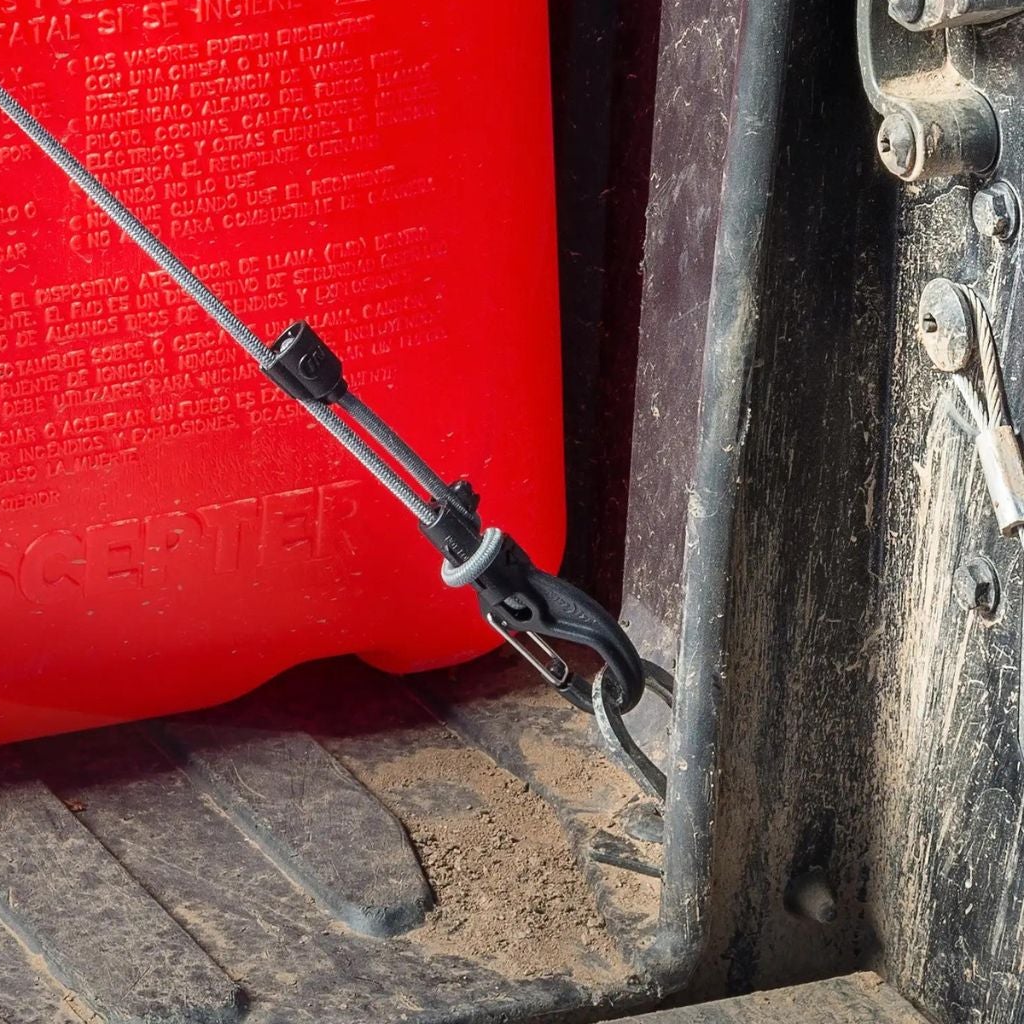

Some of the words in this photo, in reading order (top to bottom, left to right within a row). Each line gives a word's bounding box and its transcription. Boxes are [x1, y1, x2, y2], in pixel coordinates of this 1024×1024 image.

[96, 7, 125, 35] SI
[141, 0, 179, 29] SE
[83, 52, 116, 72] LOS
[124, 42, 200, 64] VAPORES
[206, 33, 270, 54] PUEDEN
[84, 72, 122, 91] CON
[128, 66, 163, 85] UNA
[167, 59, 230, 78] CHISPA
[236, 54, 251, 71] O
[258, 49, 292, 67] UNA
[298, 41, 350, 62] LLAMA
[84, 90, 139, 112] DESDE
[145, 85, 179, 103] UNA
[188, 73, 272, 96] DISTANCIA
[280, 68, 300, 85] DE
[308, 58, 364, 80] VARIOS
[200, 93, 272, 114] ALEJADO
[278, 87, 304, 105] DEL
[84, 130, 146, 150] PILOTO,
[154, 119, 231, 140] COCINAS,
[192, 140, 206, 156] Y
[210, 132, 266, 154] OTRAS
[270, 123, 342, 143] FUENTES
[179, 159, 203, 177] EL
[207, 148, 300, 172] RECIPIENTE
[163, 182, 188, 199] NO
[195, 178, 218, 194] LO
[224, 171, 257, 189] USE
[86, 212, 111, 230] NO
[168, 196, 239, 217] CUANDO
[244, 188, 276, 207] USE
[284, 182, 306, 200] EL
[86, 231, 112, 250] NO
[169, 218, 215, 238] PARA
[221, 200, 334, 228] COMBUSTIBLE
[9, 291, 30, 308] EL
[33, 276, 130, 303] DISPOSITIVO
[43, 305, 64, 322] EL
[107, 295, 130, 313] ES
[135, 290, 160, 309] UN
[15, 330, 38, 347] DE
[90, 344, 146, 367] SOBRE
[65, 370, 89, 388] DE
[0, 396, 45, 417] DEBE
[51, 382, 144, 408] UTILIZARSE
[149, 374, 194, 396] PARA
[42, 421, 57, 439] O
[62, 409, 146, 433] ACELERAR
[150, 404, 174, 423] UN
[177, 395, 232, 418] FUEGO
[235, 390, 256, 409] ES
[17, 437, 104, 461] INCENDIOS
[111, 432, 126, 449] Y
[45, 459, 66, 478] LA
[75, 449, 139, 472] MUERTE
